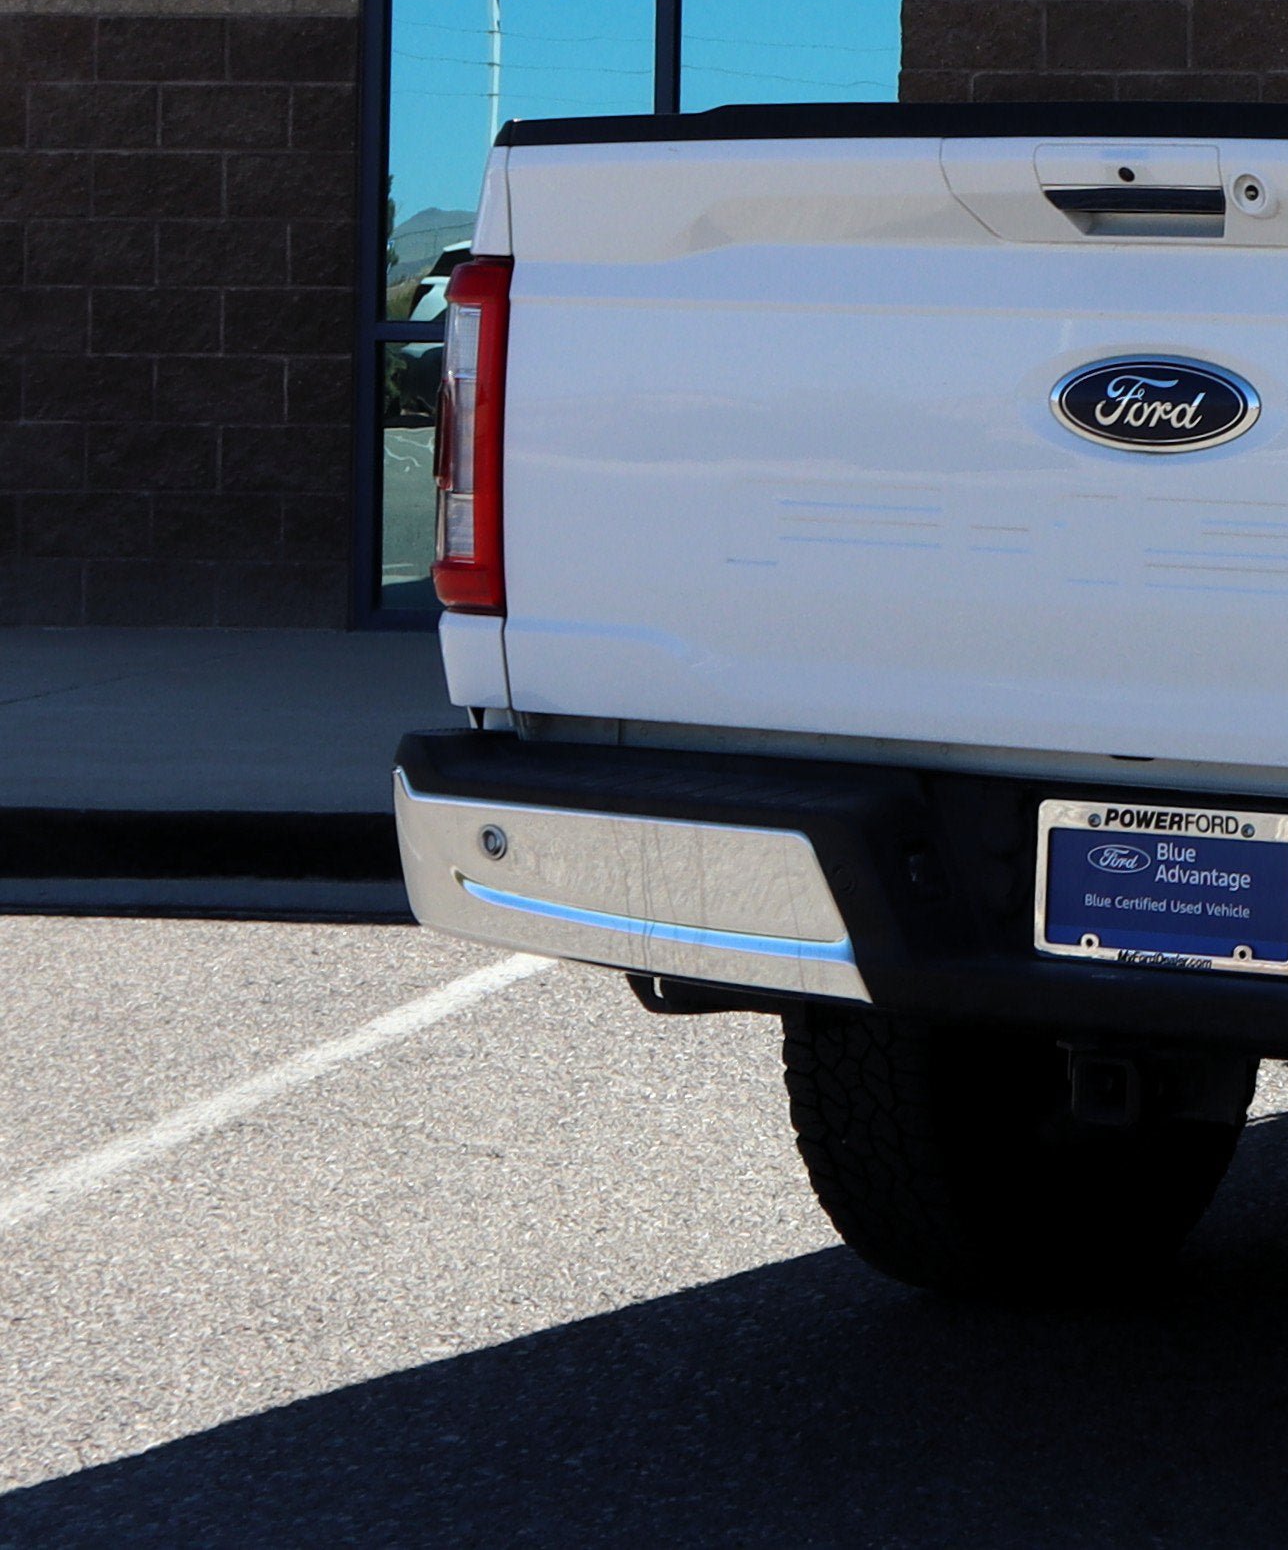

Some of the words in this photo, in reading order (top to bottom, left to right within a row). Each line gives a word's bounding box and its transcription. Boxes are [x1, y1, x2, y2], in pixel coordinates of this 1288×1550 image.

[1094, 374, 1206, 430] Ford
[1103, 807, 1240, 835] POWERFORD
[1098, 848, 1140, 870] Ford
[1156, 842, 1197, 863] Blue
[1154, 864, 1251, 892] Advantage
[1084, 893, 1112, 908] Blue
[1114, 895, 1166, 912] Certified
[1170, 899, 1202, 915] Used
[1206, 903, 1251, 919] Vehicle
